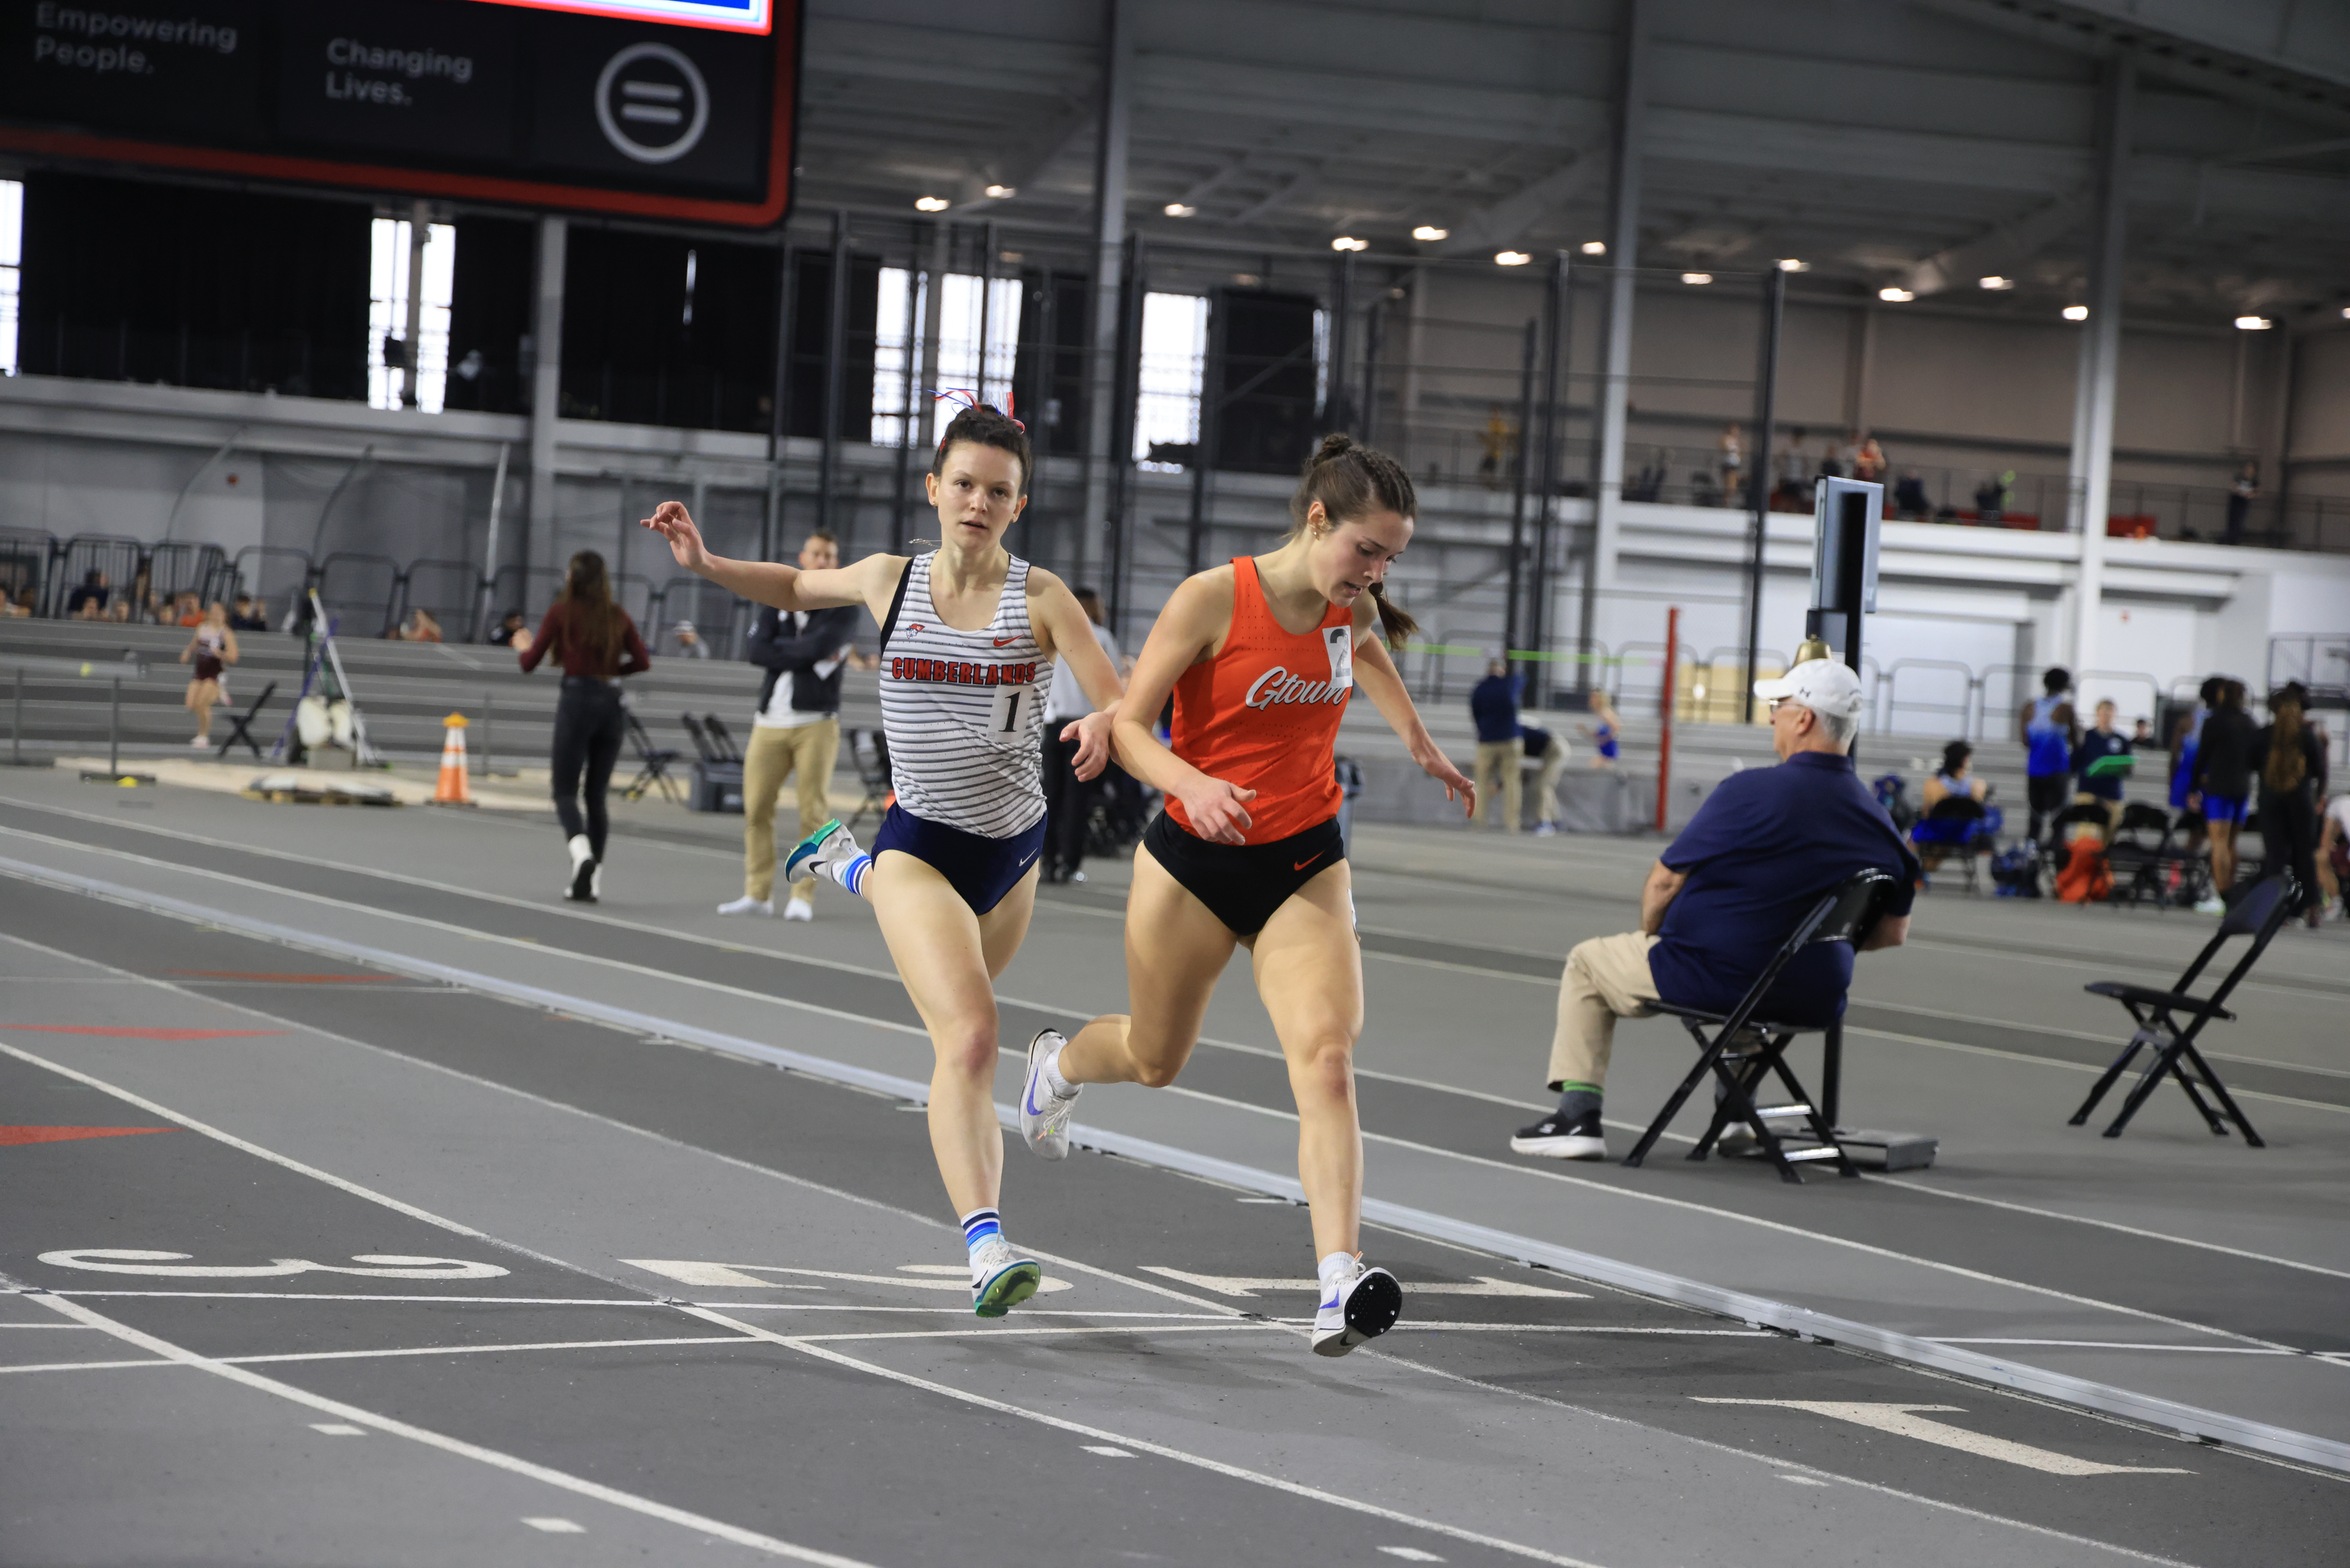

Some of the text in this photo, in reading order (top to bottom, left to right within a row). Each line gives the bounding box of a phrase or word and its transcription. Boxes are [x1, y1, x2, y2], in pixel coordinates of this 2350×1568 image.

[36, 2, 237, 54] Empowering
[35, 35, 155, 74] People.
[326, 37, 473, 84] Changing
[325, 70, 412, 106] Lives.
[891, 657, 1037, 685] CUMBERLANDS
[1329, 628, 1351, 677] 2
[1245, 665, 1347, 711] Gtown
[997, 691, 1021, 733] 1
